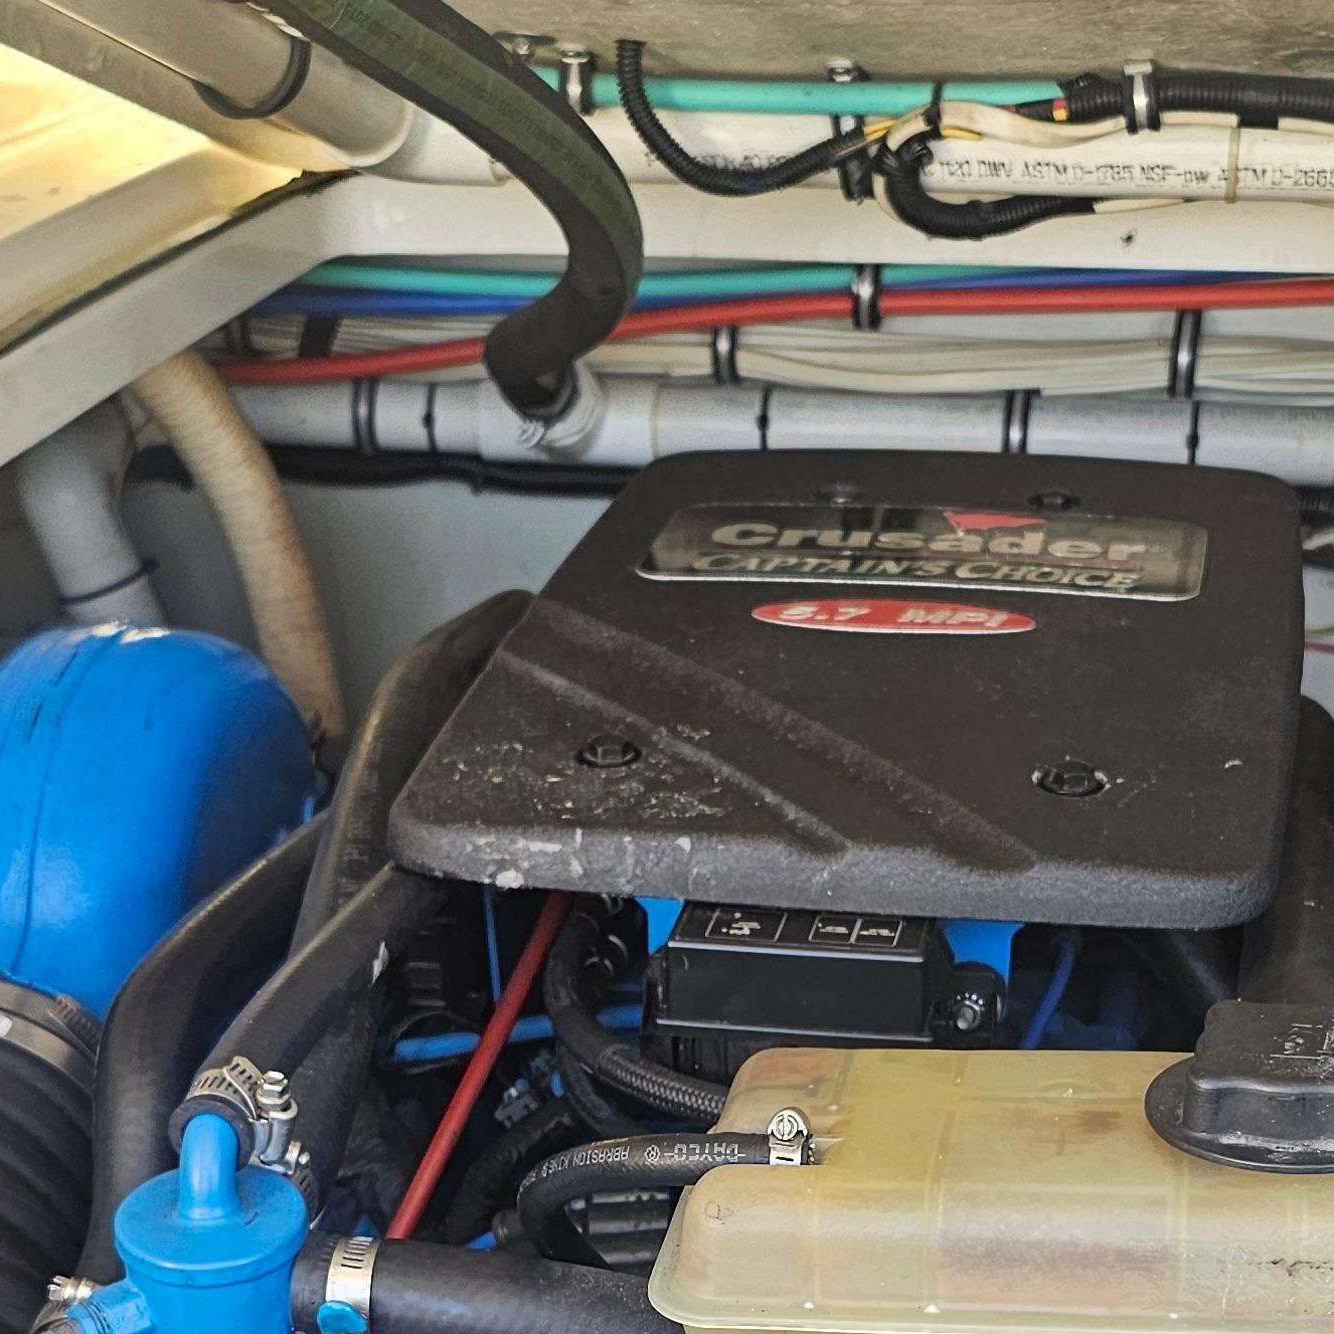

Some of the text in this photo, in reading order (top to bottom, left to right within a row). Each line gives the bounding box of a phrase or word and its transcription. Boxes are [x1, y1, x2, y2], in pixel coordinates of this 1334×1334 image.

[710, 522, 1147, 563] Crusader
[694, 552, 1142, 590] CAPTAIN'S CHOICE
[779, 607, 1010, 628] 5.7 MPI
